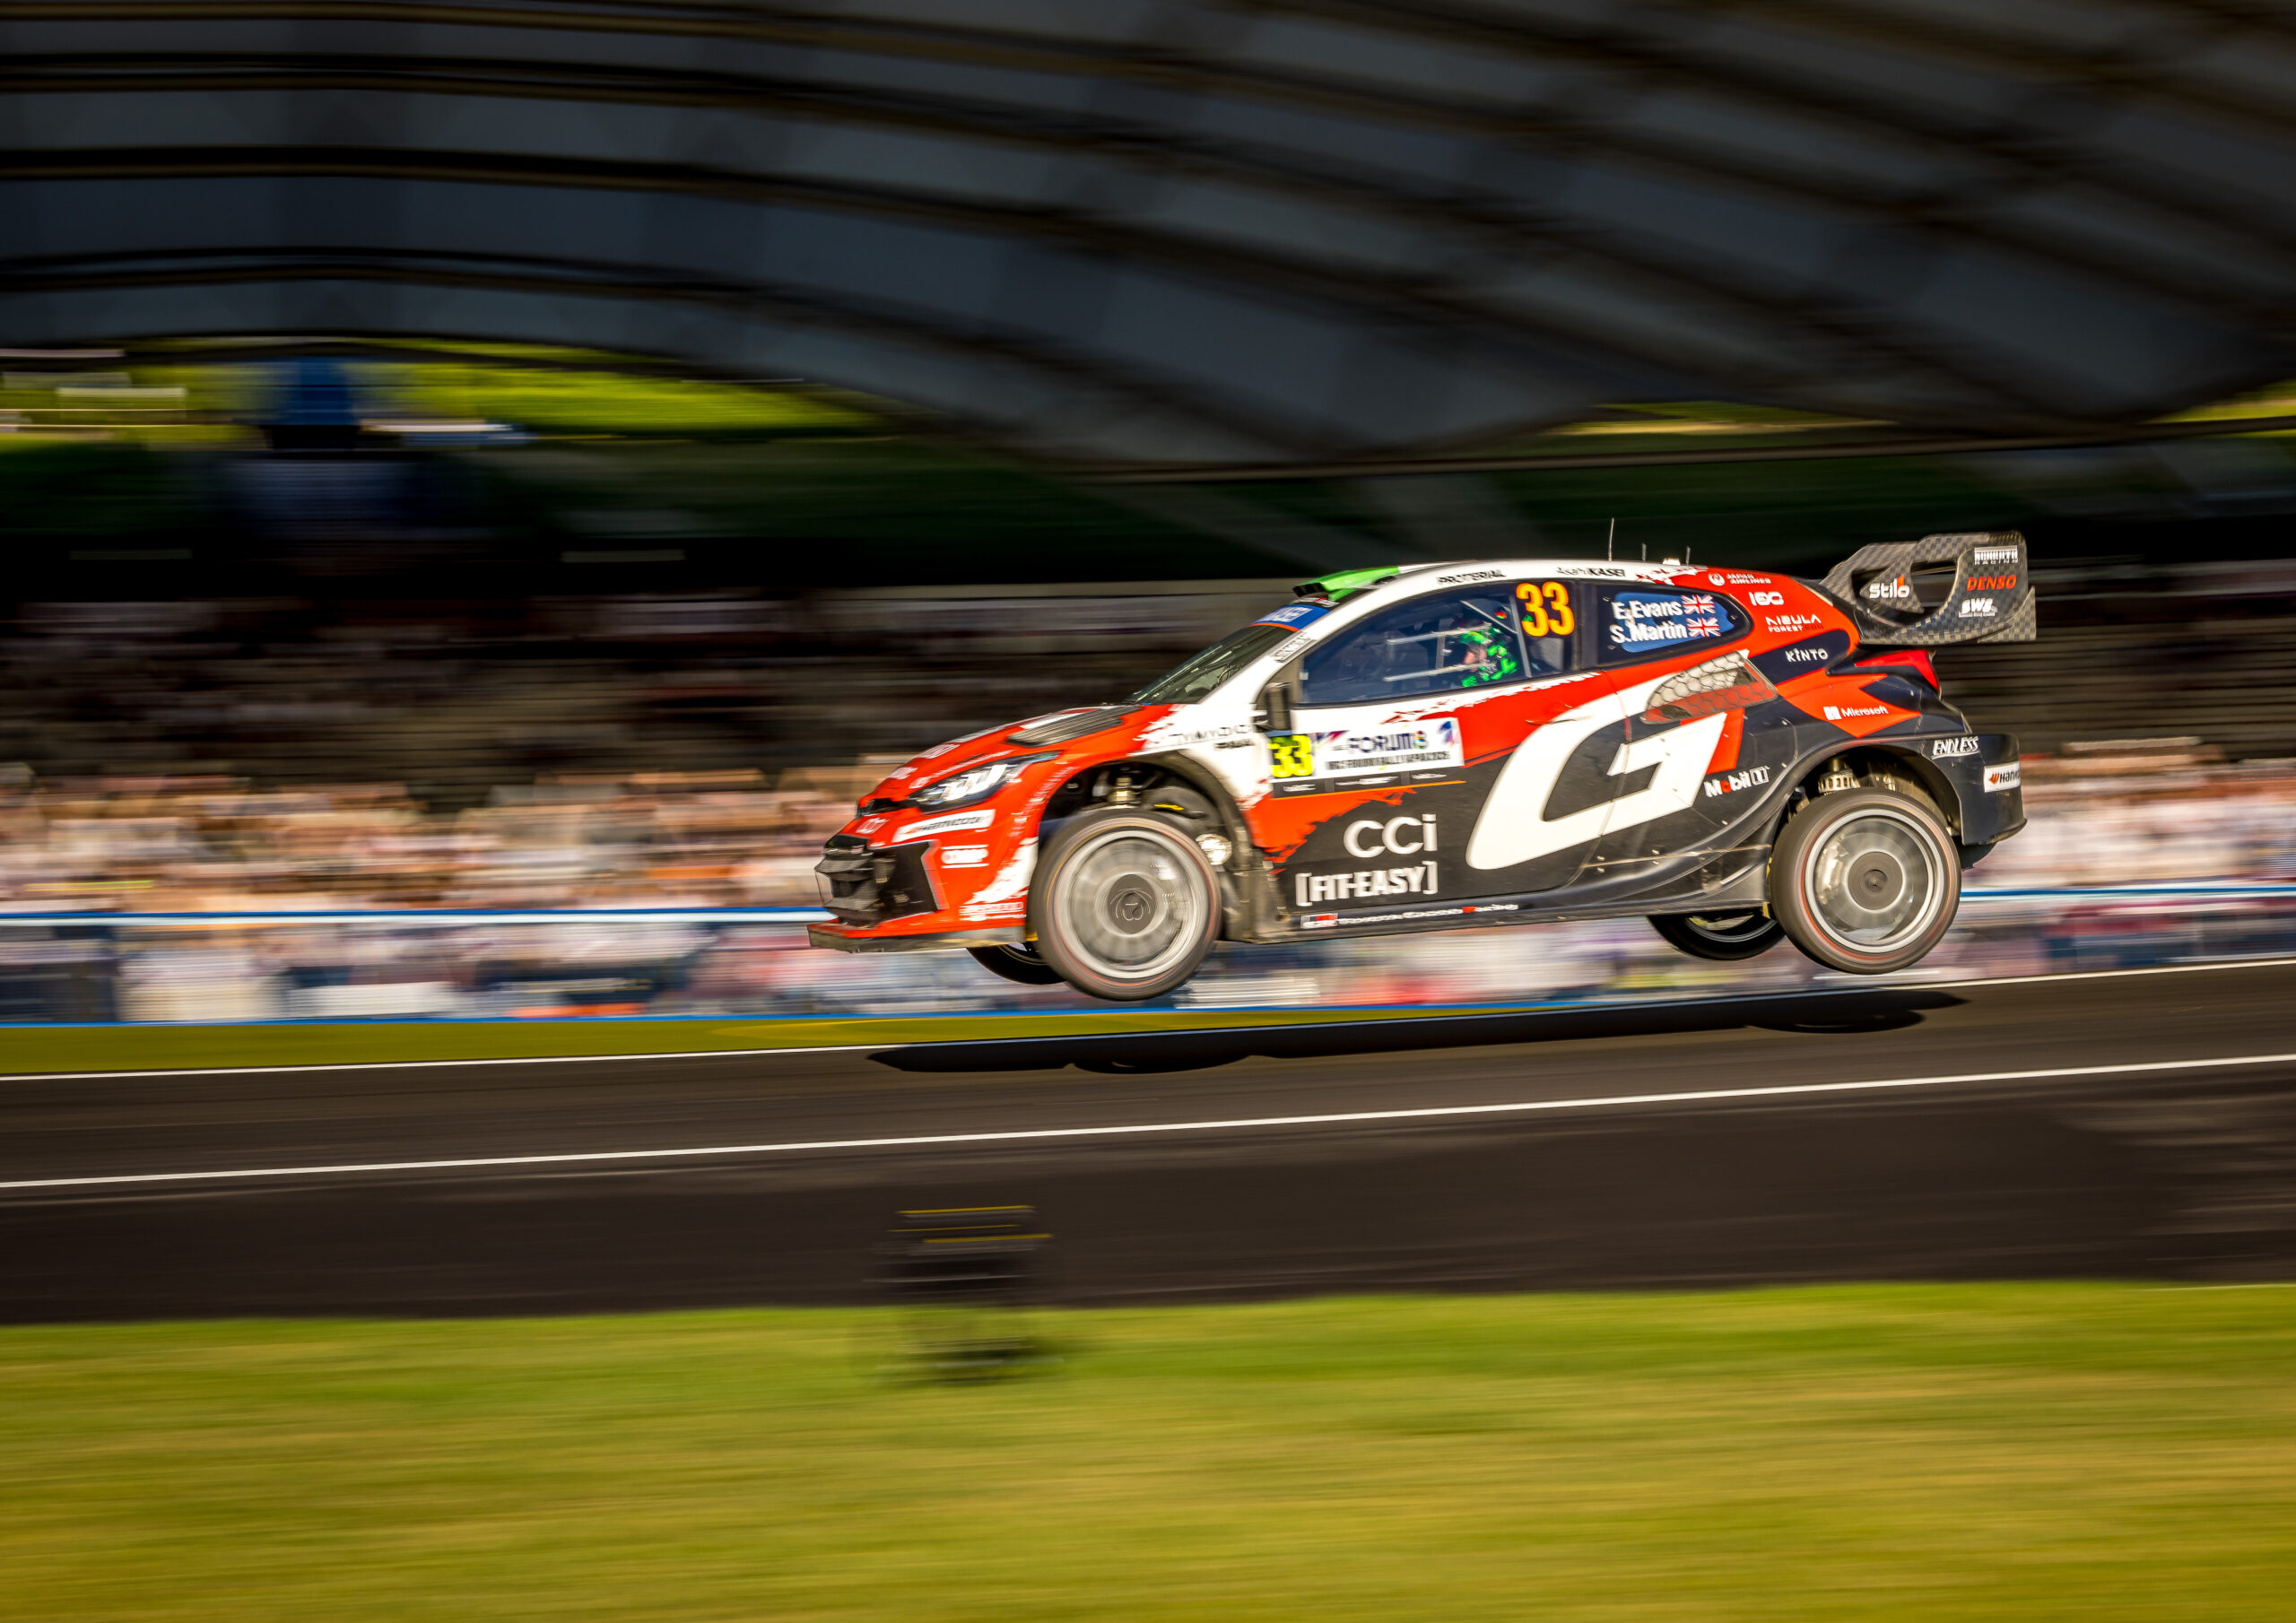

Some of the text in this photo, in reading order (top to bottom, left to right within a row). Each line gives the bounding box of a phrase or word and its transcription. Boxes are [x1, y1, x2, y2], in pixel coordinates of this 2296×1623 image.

[1869, 577, 1910, 599] Stilo
[1967, 575, 2017, 591] DENSO
[1516, 581, 1575, 637] 33
[1612, 600, 1683, 620] E.Evans
[1610, 621, 1688, 643] S.Martin
[1785, 647, 1829, 663] KINTO
[1840, 705, 1889, 717] Microsoft
[1268, 733, 1314, 778] 33
[1932, 736, 1979, 757] ENDLESS
[1703, 771, 1752, 797] Mobil
